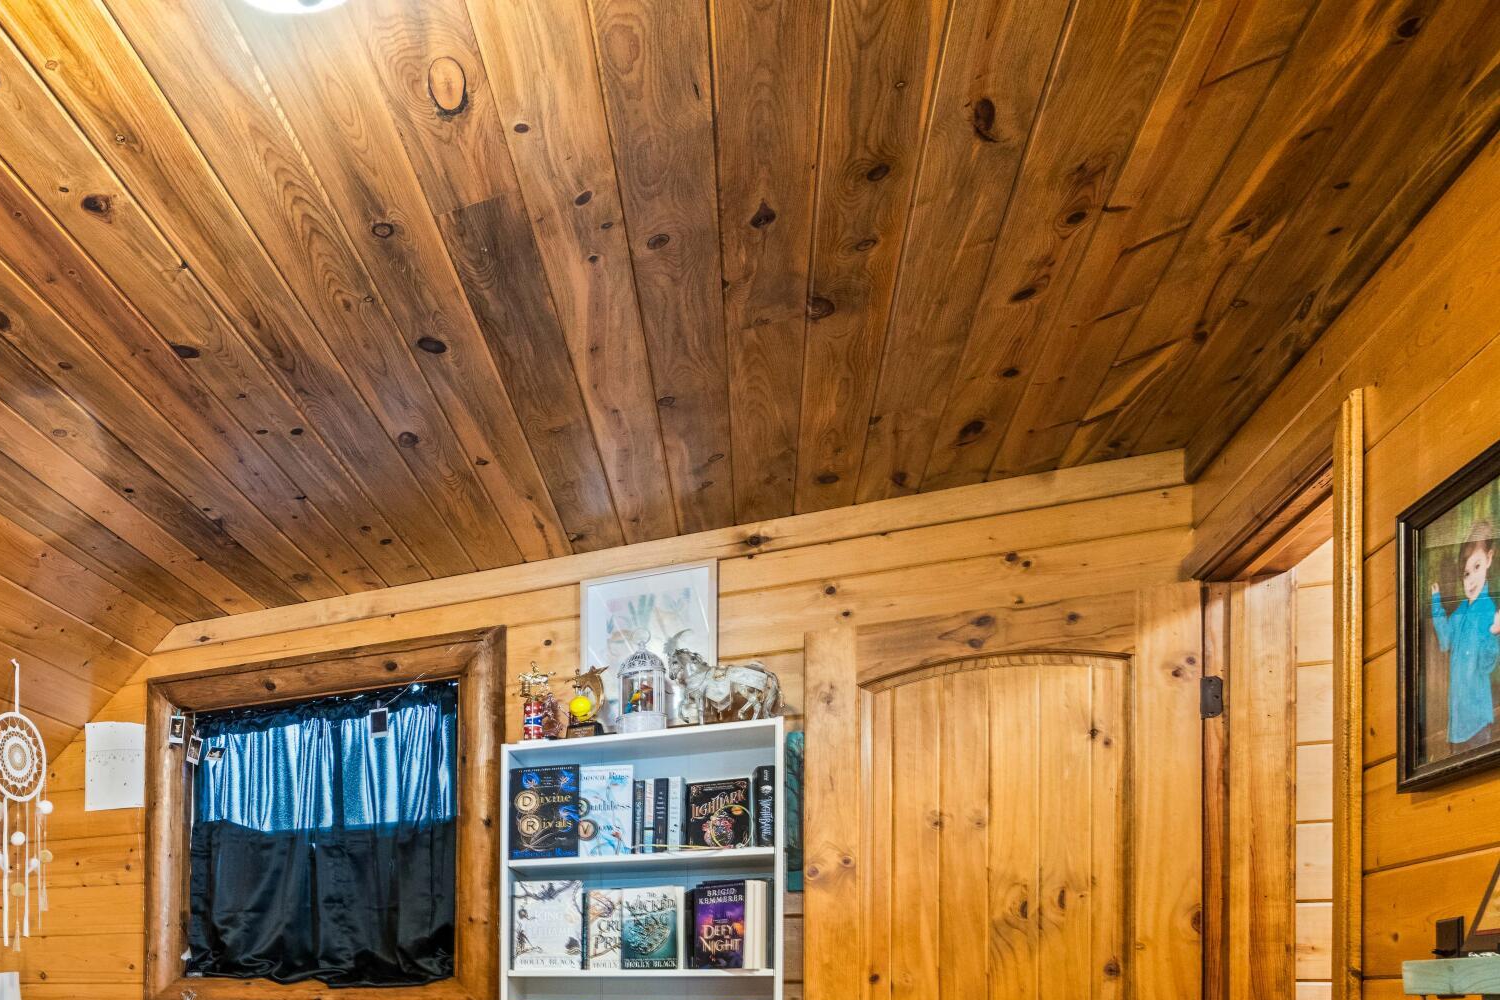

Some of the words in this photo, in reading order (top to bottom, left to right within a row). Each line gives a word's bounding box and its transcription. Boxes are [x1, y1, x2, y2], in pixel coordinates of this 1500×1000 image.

[521, 792, 573, 808] Divine
[525, 817, 573, 831] Rivals
[706, 887, 737, 897] BRIGID
[701, 924, 733, 939] DEFY
[699, 936, 742, 955] NIGHT
